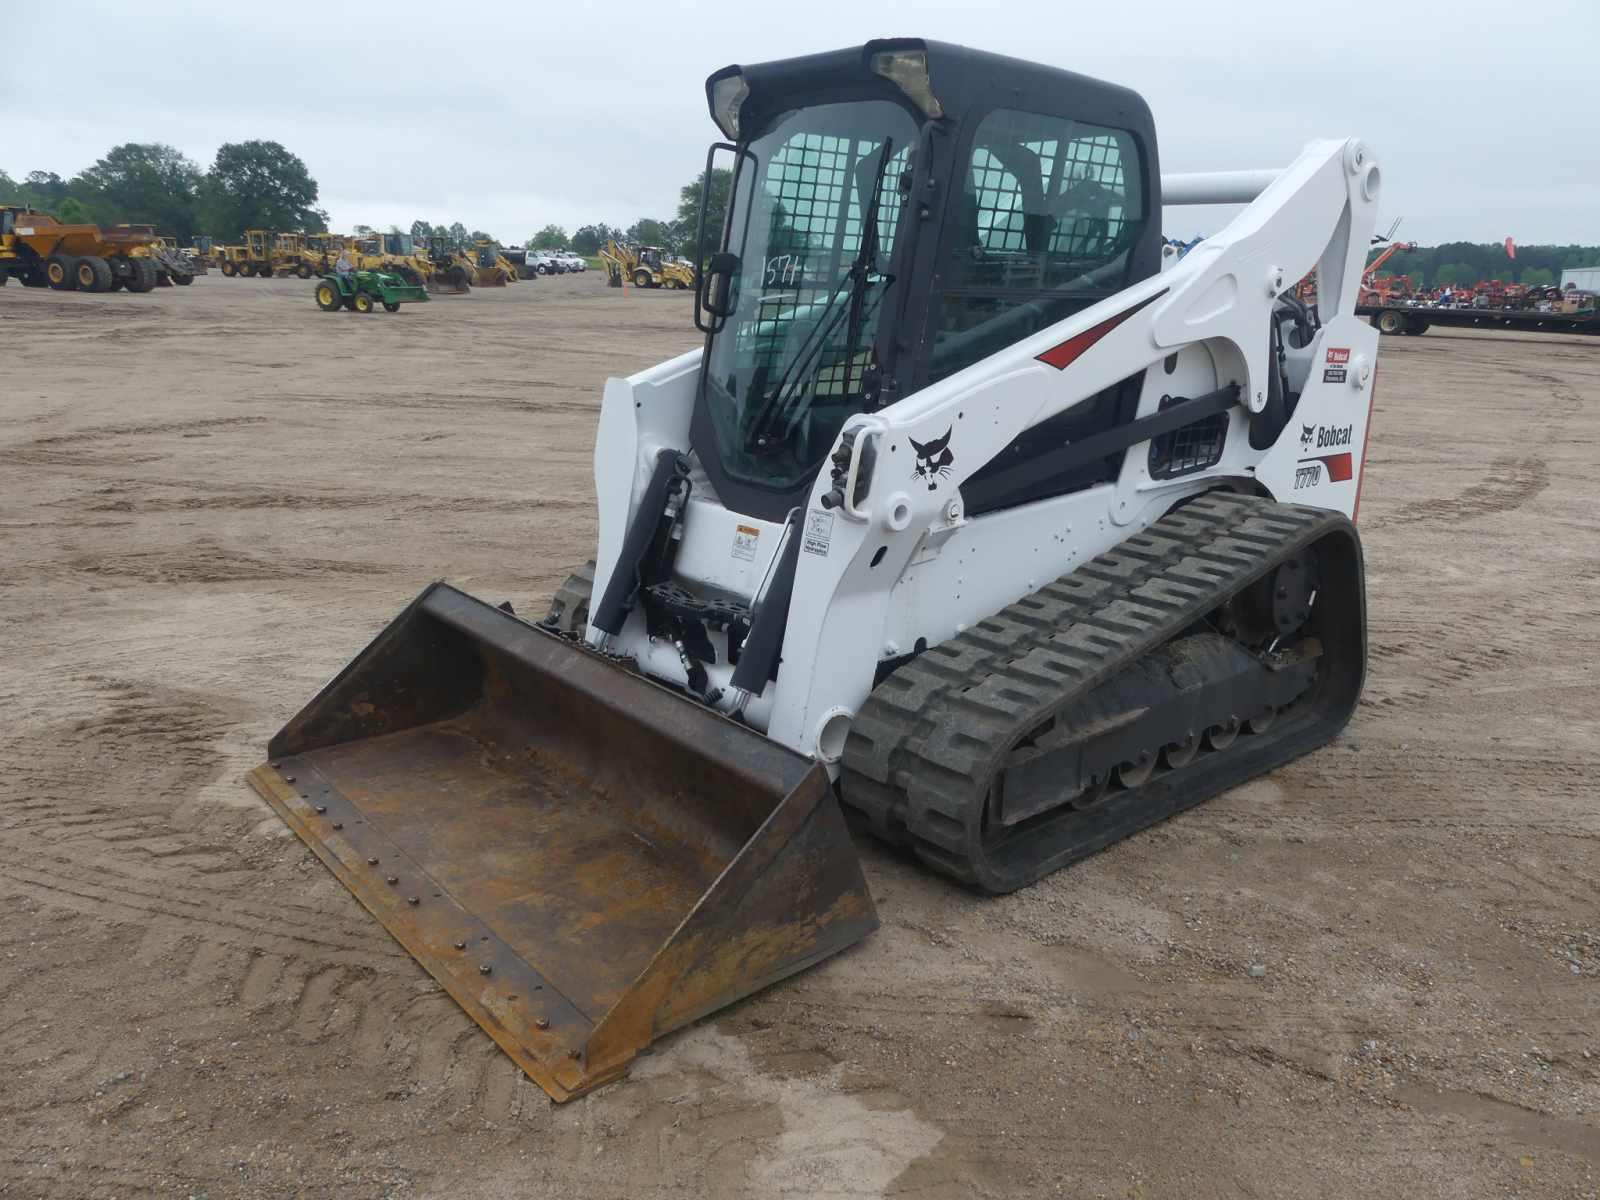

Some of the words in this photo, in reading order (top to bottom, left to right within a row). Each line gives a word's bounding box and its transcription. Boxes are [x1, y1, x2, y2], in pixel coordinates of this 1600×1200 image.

[760, 254, 799, 286] 1571
[1317, 424, 1352, 448] Bobcat
[1294, 465, 1321, 490] T770
